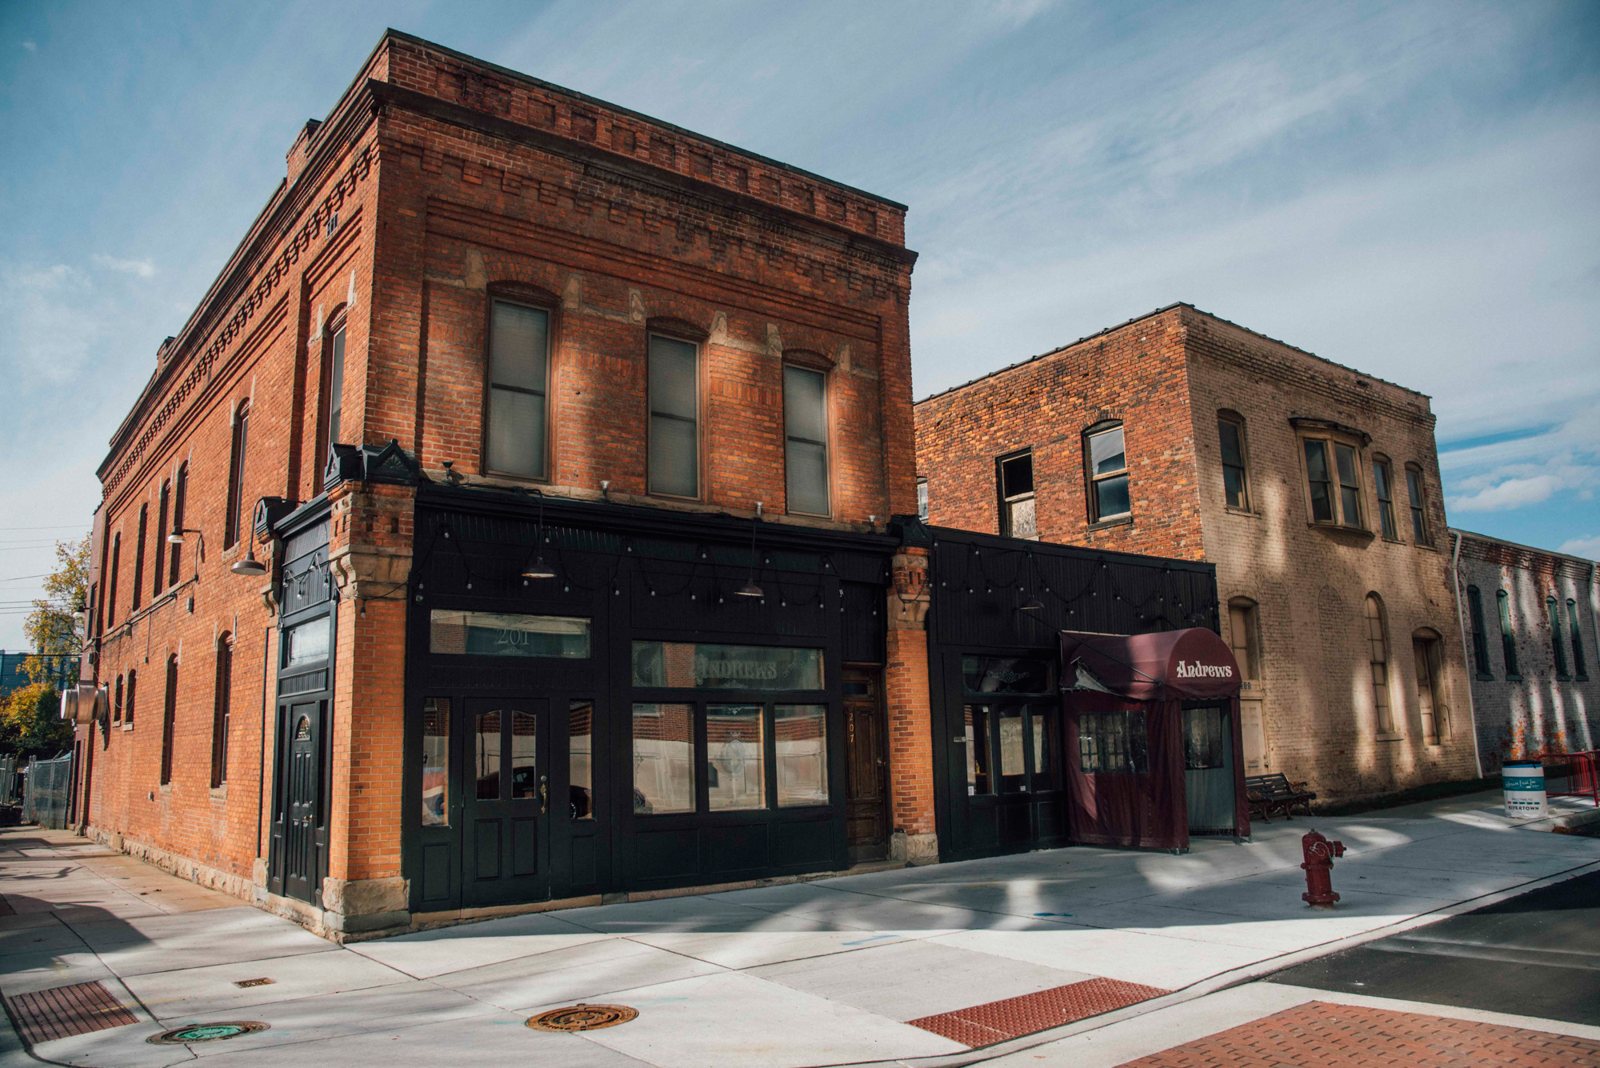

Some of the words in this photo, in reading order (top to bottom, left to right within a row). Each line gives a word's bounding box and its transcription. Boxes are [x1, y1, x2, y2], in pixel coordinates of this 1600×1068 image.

[497, 627, 529, 645] 201
[693, 655, 777, 684] ANDREWS
[1176, 660, 1233, 678] Andrews
